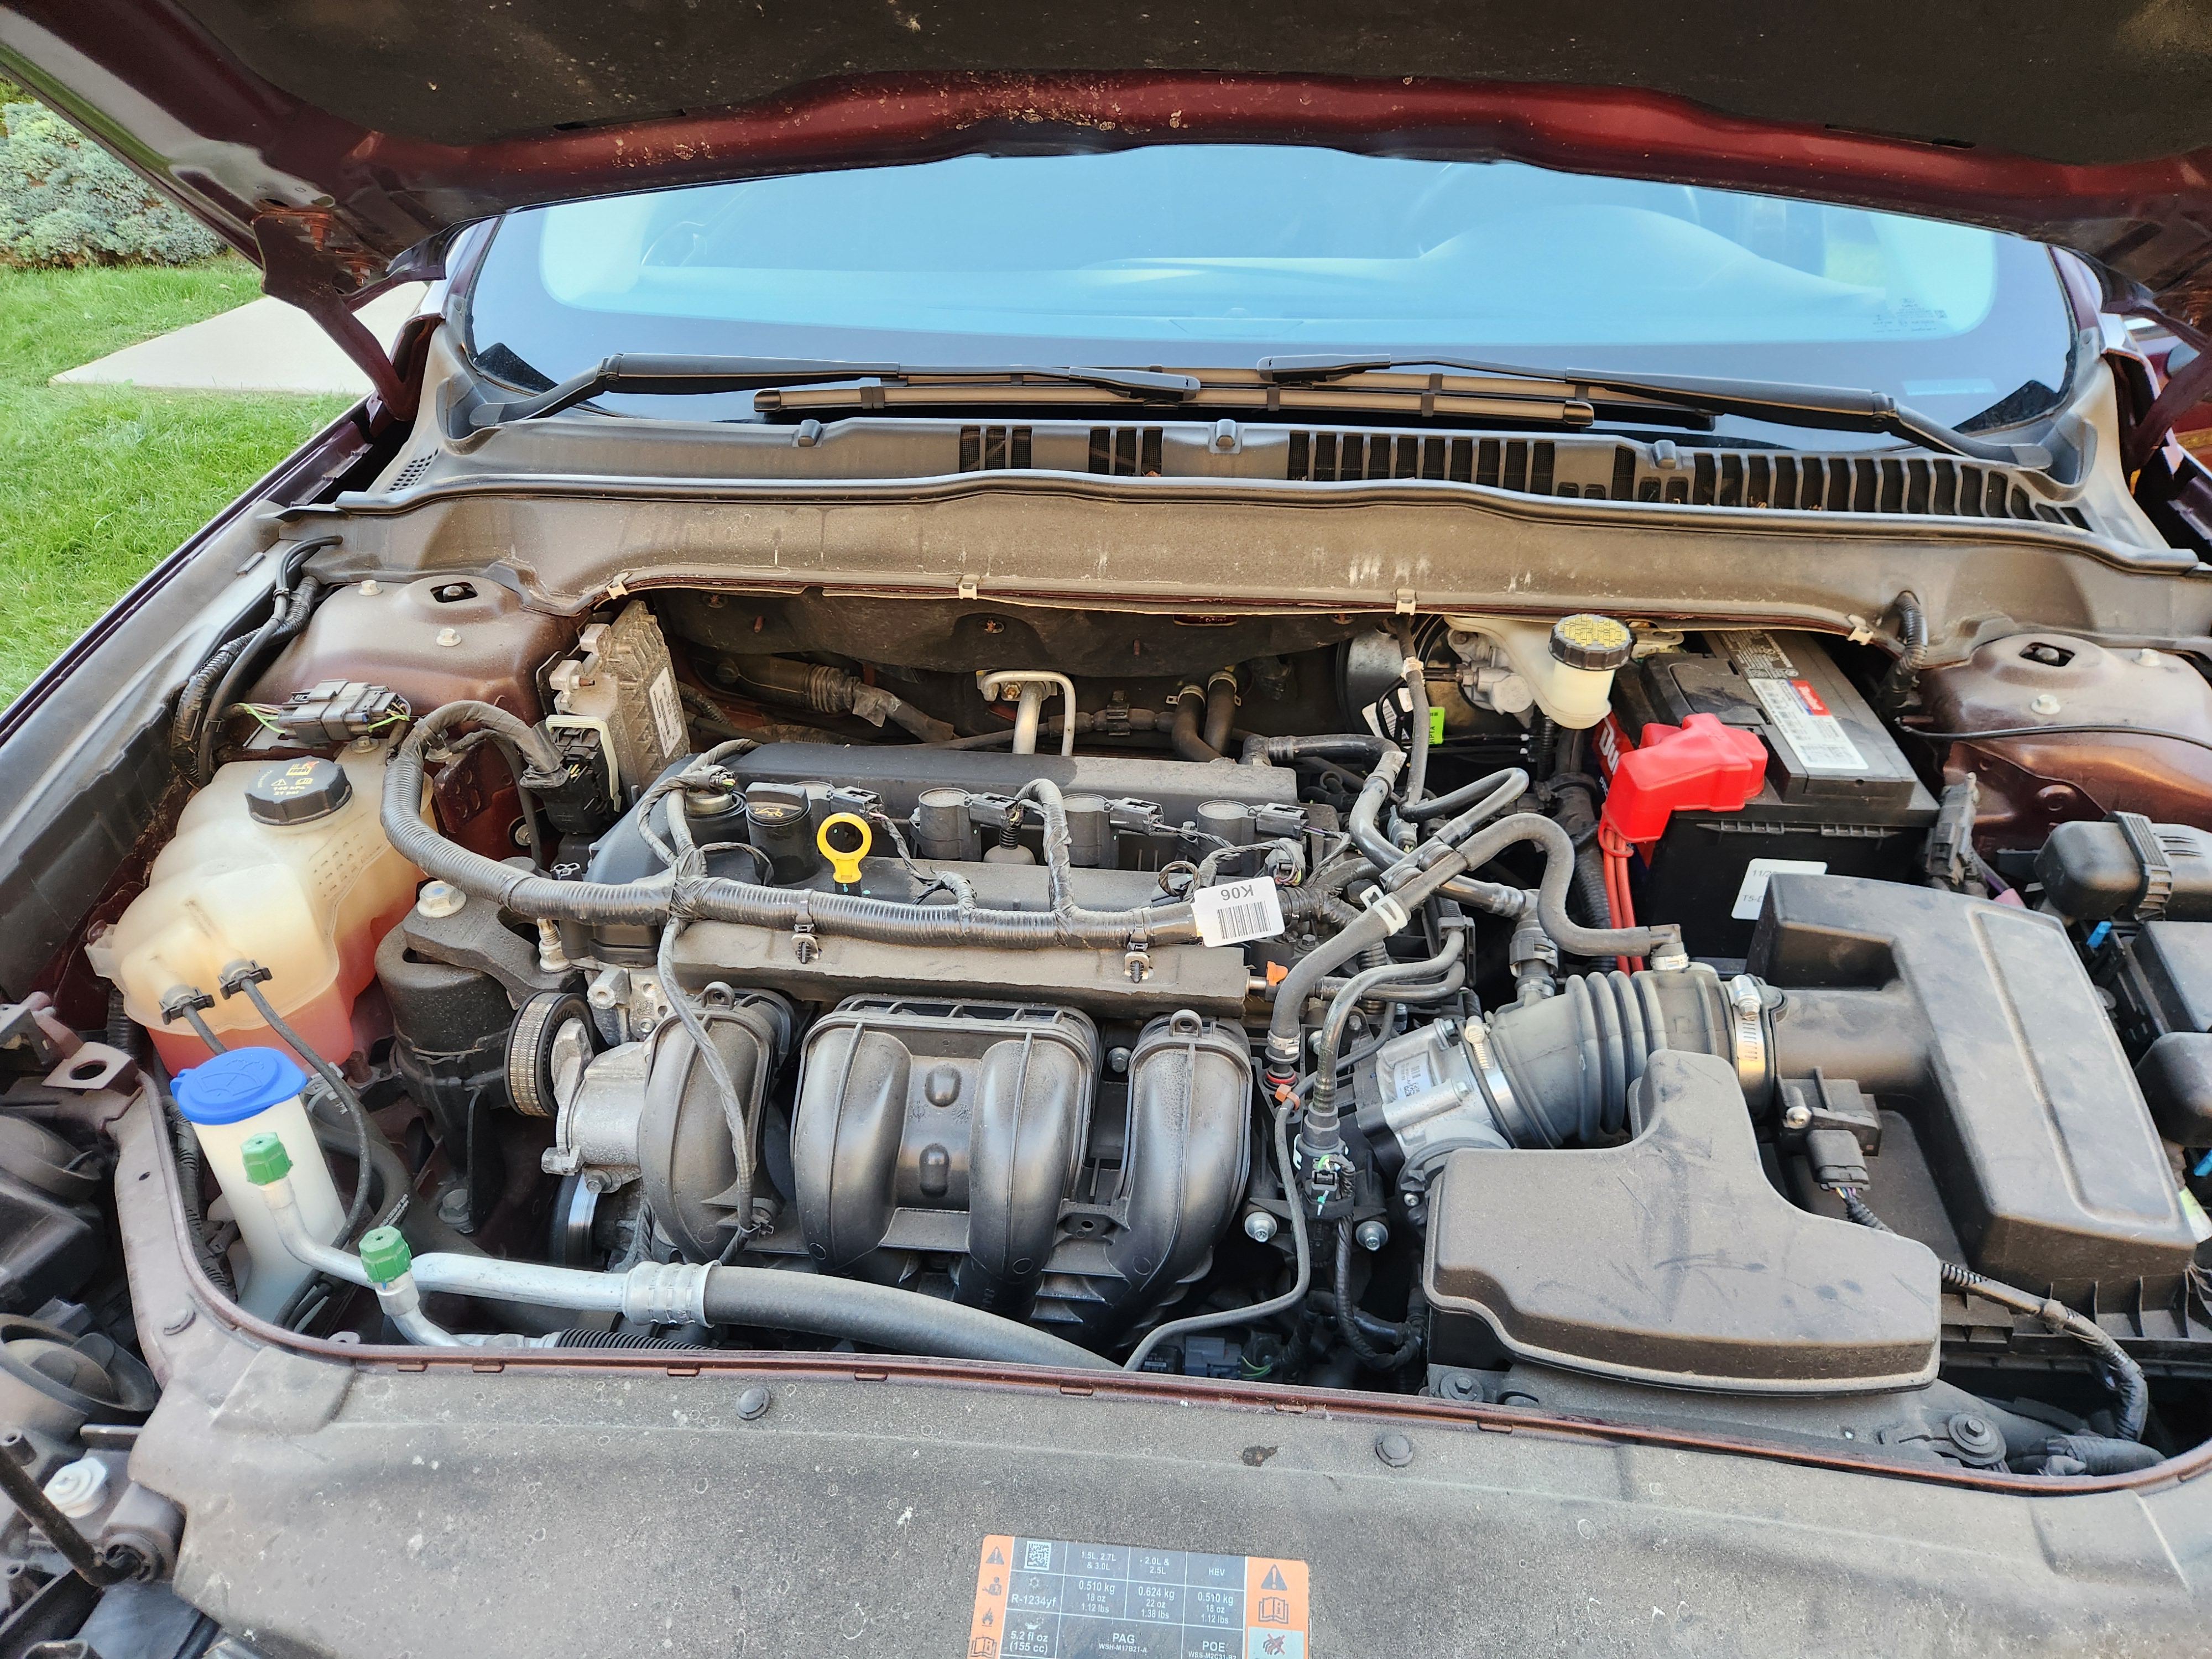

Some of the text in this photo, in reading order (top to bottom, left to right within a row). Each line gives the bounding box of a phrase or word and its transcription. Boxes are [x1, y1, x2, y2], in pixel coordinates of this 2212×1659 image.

[1220, 884, 1254, 901] K06
[1100, 1553, 1117, 1562] 2.7L
[1145, 1557, 1161, 1566] 2.0L
[1095, 1562, 1110, 1571] 3.0L
[1150, 1566, 1166, 1574] 2.5L
[1208, 1568, 1225, 1576] HEV
[1079, 1580, 1115, 1595] 0.510 kg
[1087, 1593, 1095, 1601] 18
[1138, 1586, 1175, 1601] 0.624 kg
[1011, 1594, 1056, 1609] R-1234yf
[1146, 1599, 1155, 1607] 22
[1198, 1592, 1234, 1606] 0.510 kg
[1081, 1603, 1109, 1613] 1.12 lbs
[1206, 1604, 1214, 1613] 18
[1141, 1609, 1170, 1619] 1.38 lbs
[1201, 1614, 1229, 1624] 1.12 lbs
[1010, 1630, 1025, 1640] 5.2
[1027, 1631, 1034, 1641] fl
[1113, 1632, 1135, 1644] PAG
[1010, 1641, 1048, 1655] (155 cc)
[1202, 1640, 1225, 1652] POE
